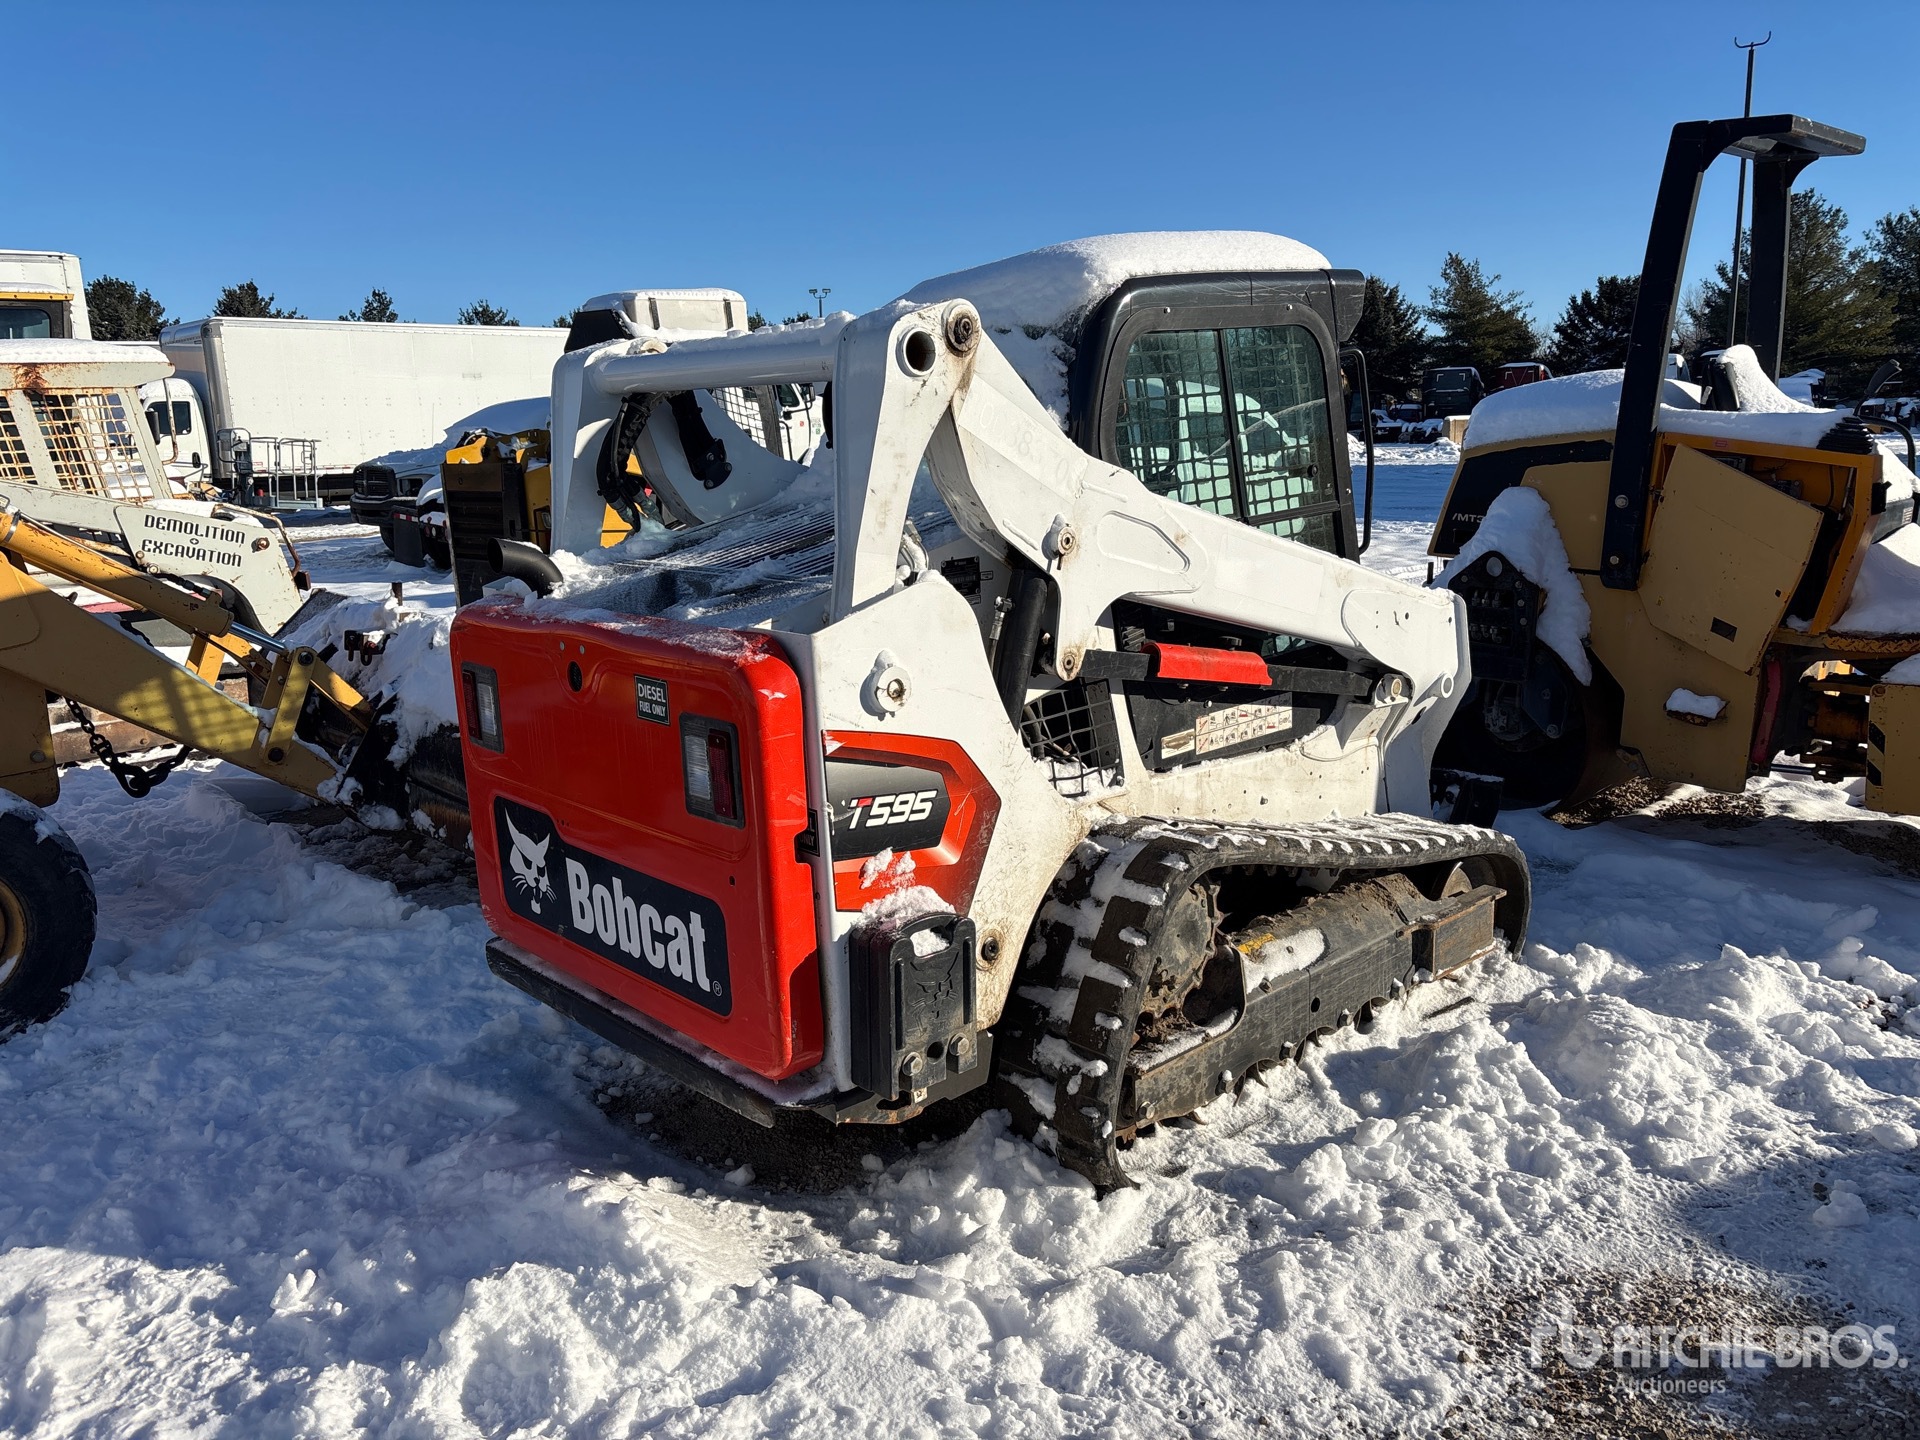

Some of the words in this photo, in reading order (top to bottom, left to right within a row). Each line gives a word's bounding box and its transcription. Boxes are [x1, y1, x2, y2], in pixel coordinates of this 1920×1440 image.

[144, 514, 246, 544] DEMOLITION
[141, 539, 242, 567] EXCAVATION
[637, 683, 666, 702] DIESEL
[639, 700, 651, 713] FUEL
[652, 703, 666, 717] ONLY
[849, 790, 938, 830] T595
[565, 857, 711, 993] Bobcat
